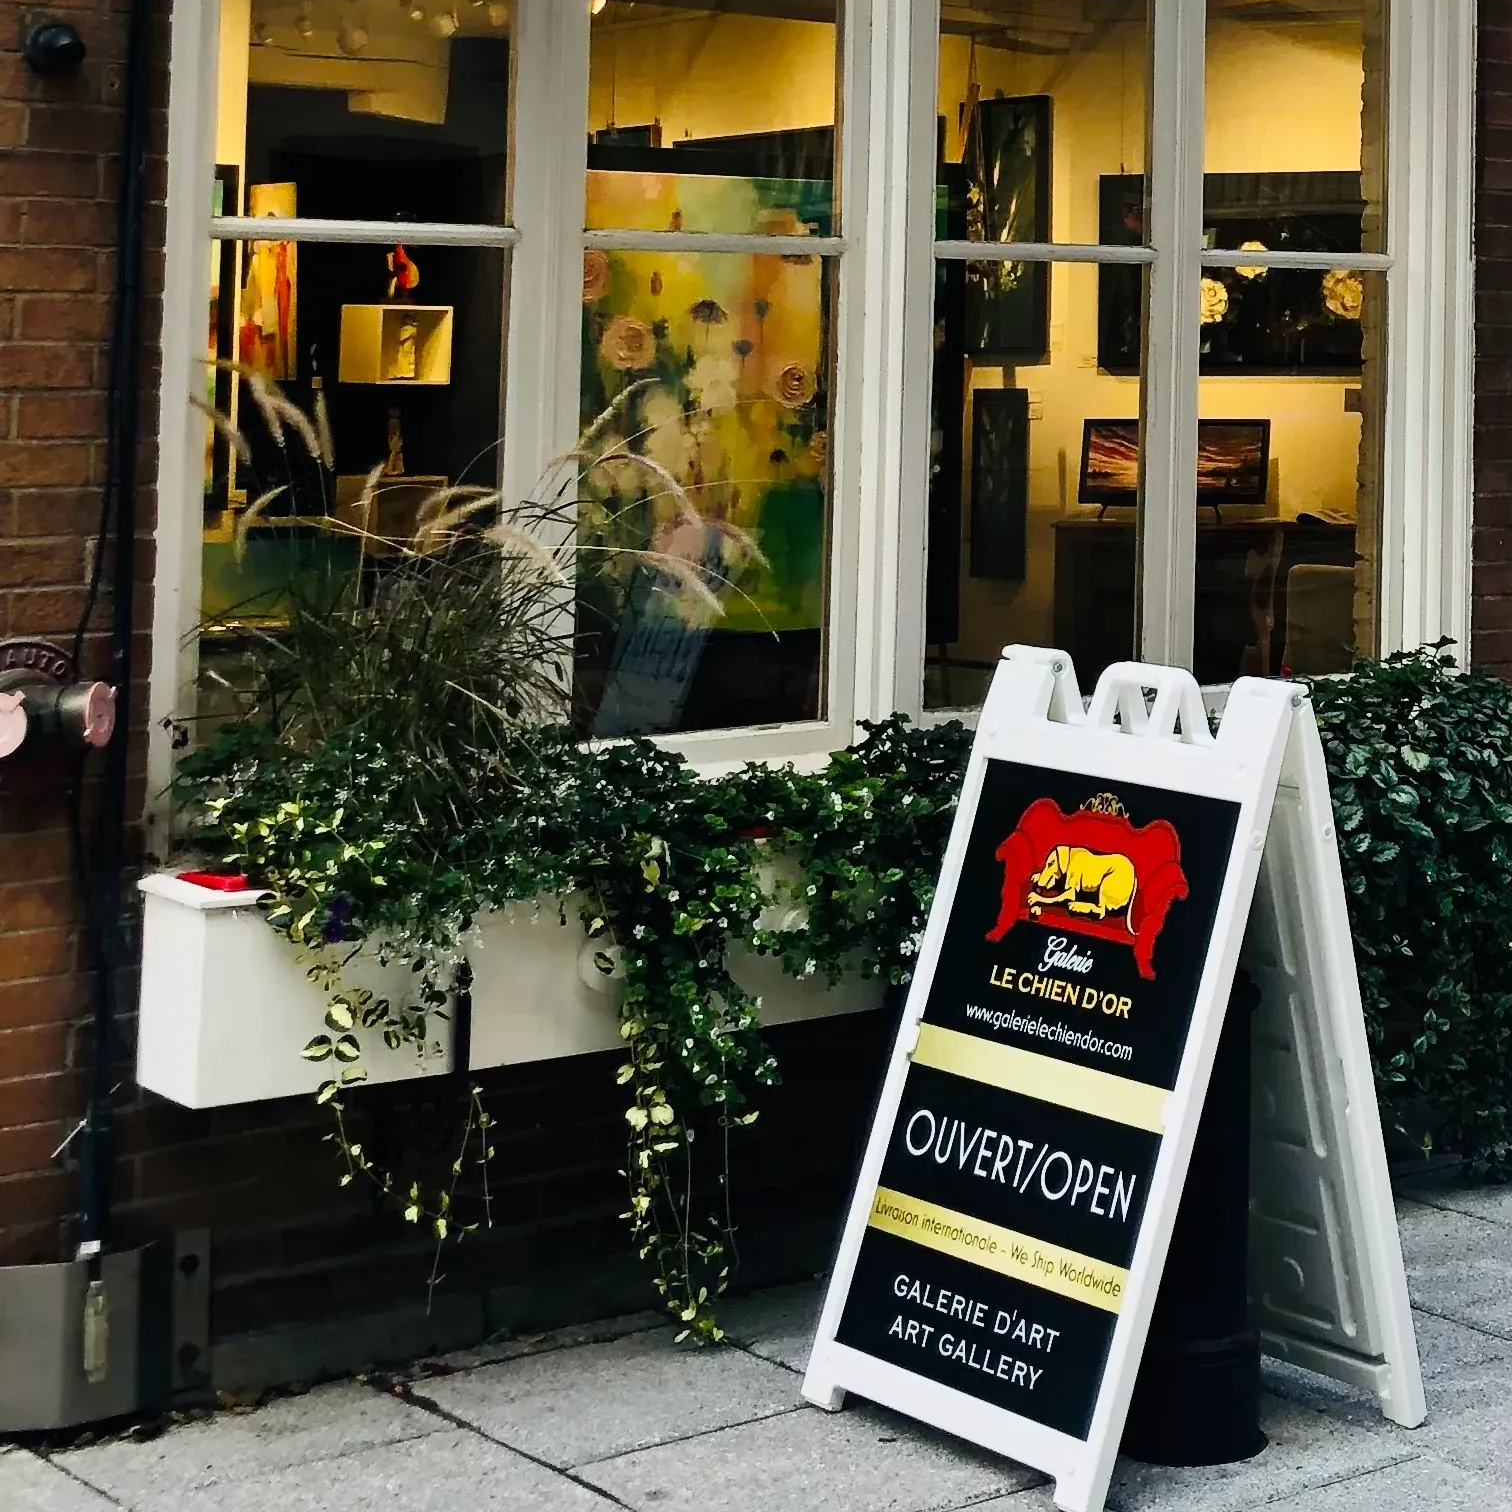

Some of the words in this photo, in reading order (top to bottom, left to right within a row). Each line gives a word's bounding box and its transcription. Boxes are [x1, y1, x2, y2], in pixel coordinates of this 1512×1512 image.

[989, 964, 1017, 989] LE
[1018, 972, 1080, 1006] CHIEN
[1081, 989, 1133, 1019] D'OR
[1038, 935, 1094, 974] Galerie
[966, 1003, 1133, 1061] www.galerielechiendor.com
[905, 1109, 1137, 1223] OUVERT/OPEN
[875, 1196, 919, 1228] Livraison
[921, 1213, 998, 1254] internationale
[1011, 1241, 1029, 1265] We
[1032, 1250, 1055, 1277] Ship
[1059, 1258, 1122, 1298] Worldwide
[893, 1274, 989, 1328] GALERIE
[994, 1309, 1060, 1353] D'ART
[889, 1315, 935, 1349] ART
[938, 1333, 1044, 1390] GALLERY
